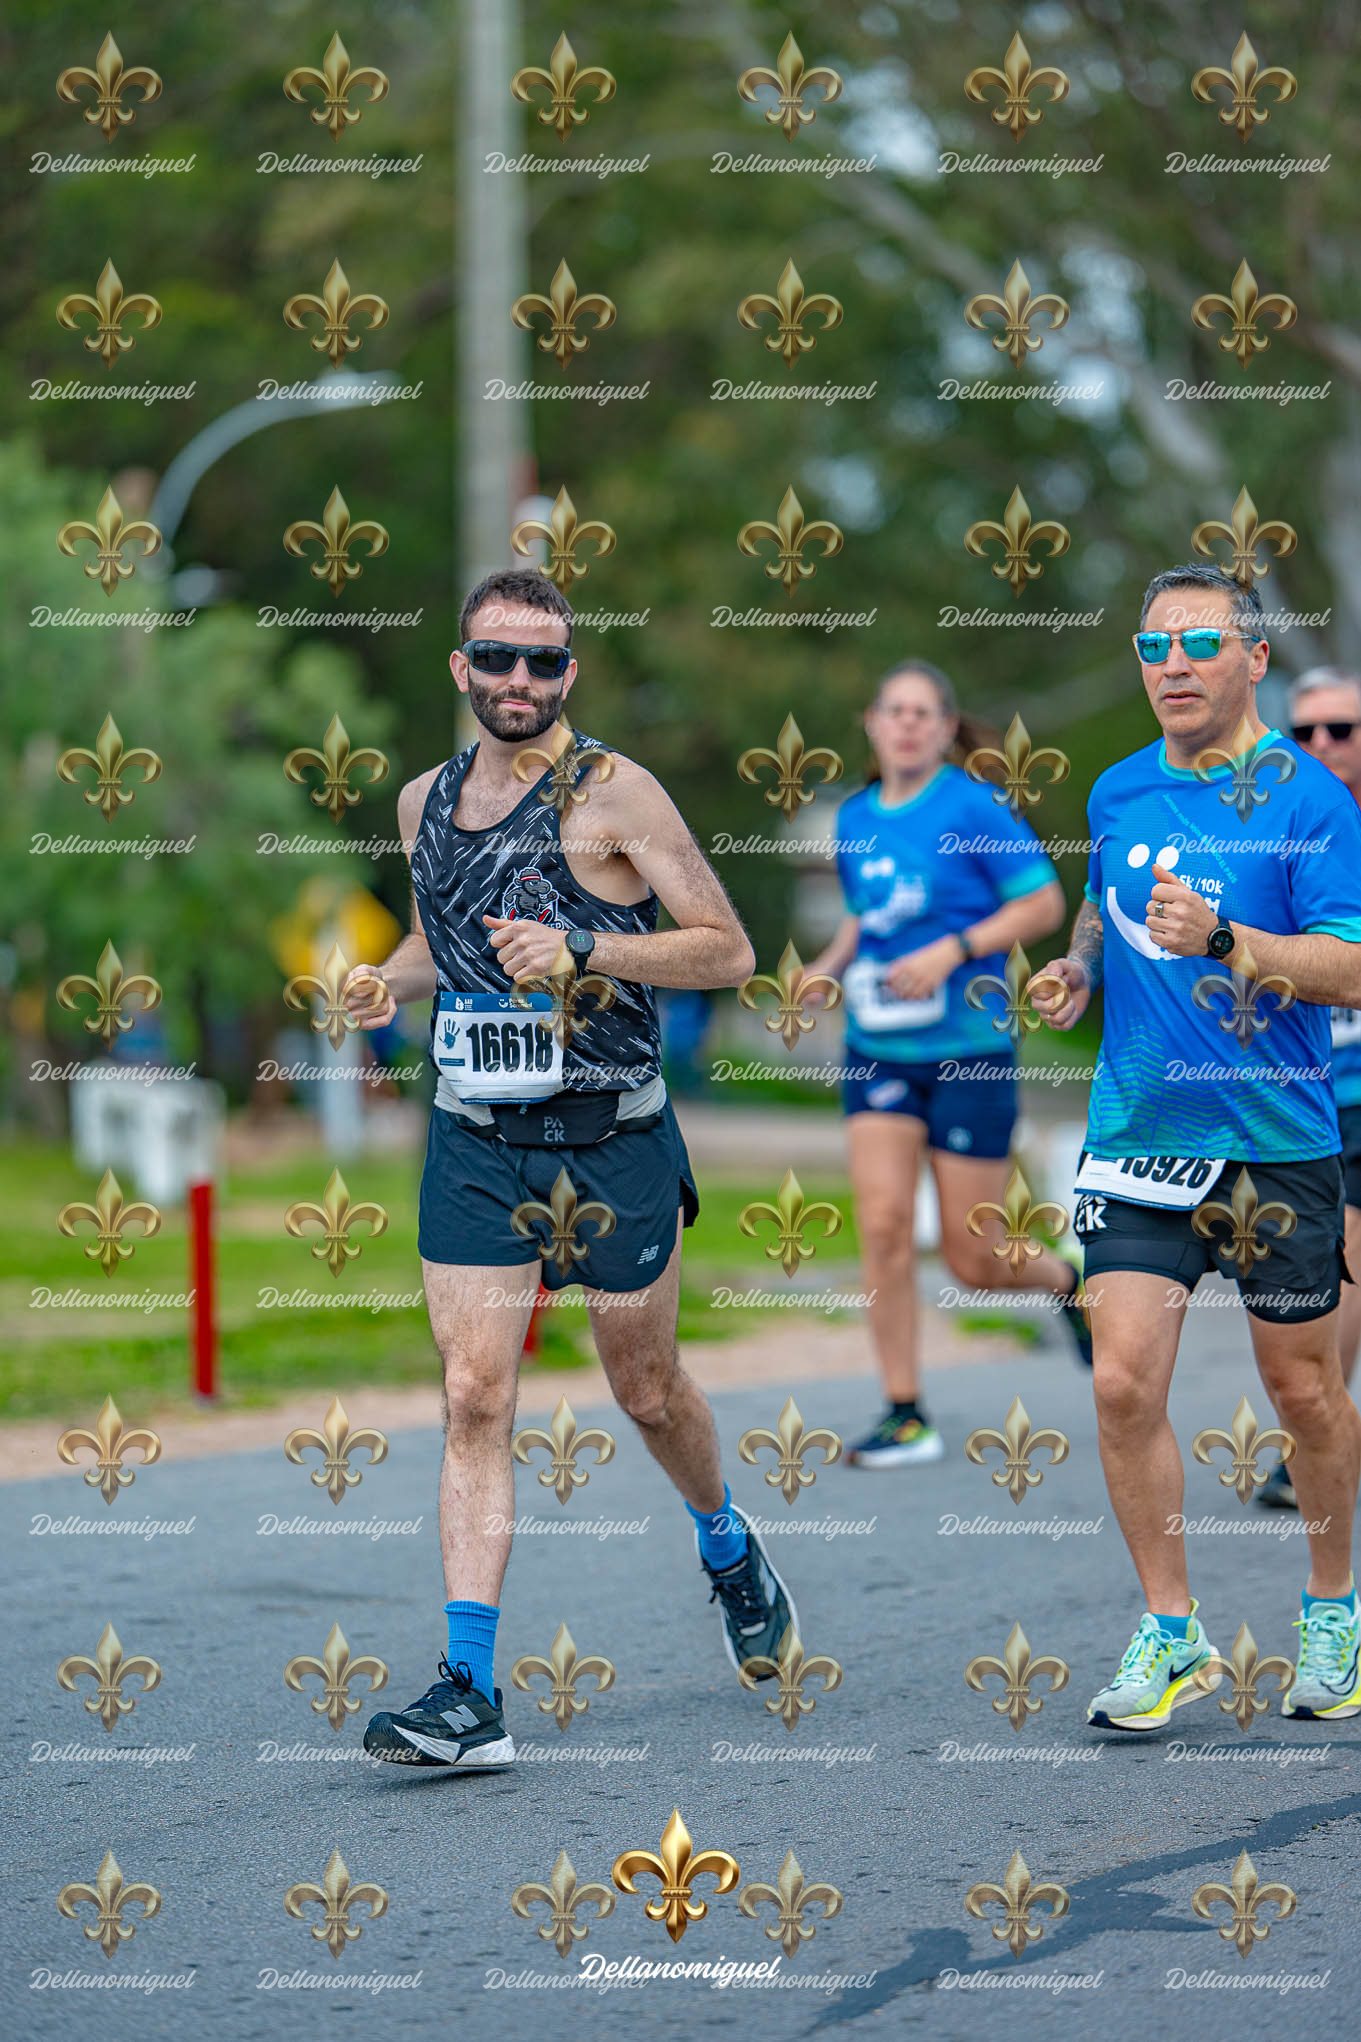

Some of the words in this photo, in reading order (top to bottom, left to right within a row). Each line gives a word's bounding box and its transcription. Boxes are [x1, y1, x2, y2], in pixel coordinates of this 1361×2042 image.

[466, 1022, 554, 1073] 16618
[544, 1116, 565, 1129] PA
[544, 1130, 565, 1142] CK
[439, 1704, 481, 1735] N
